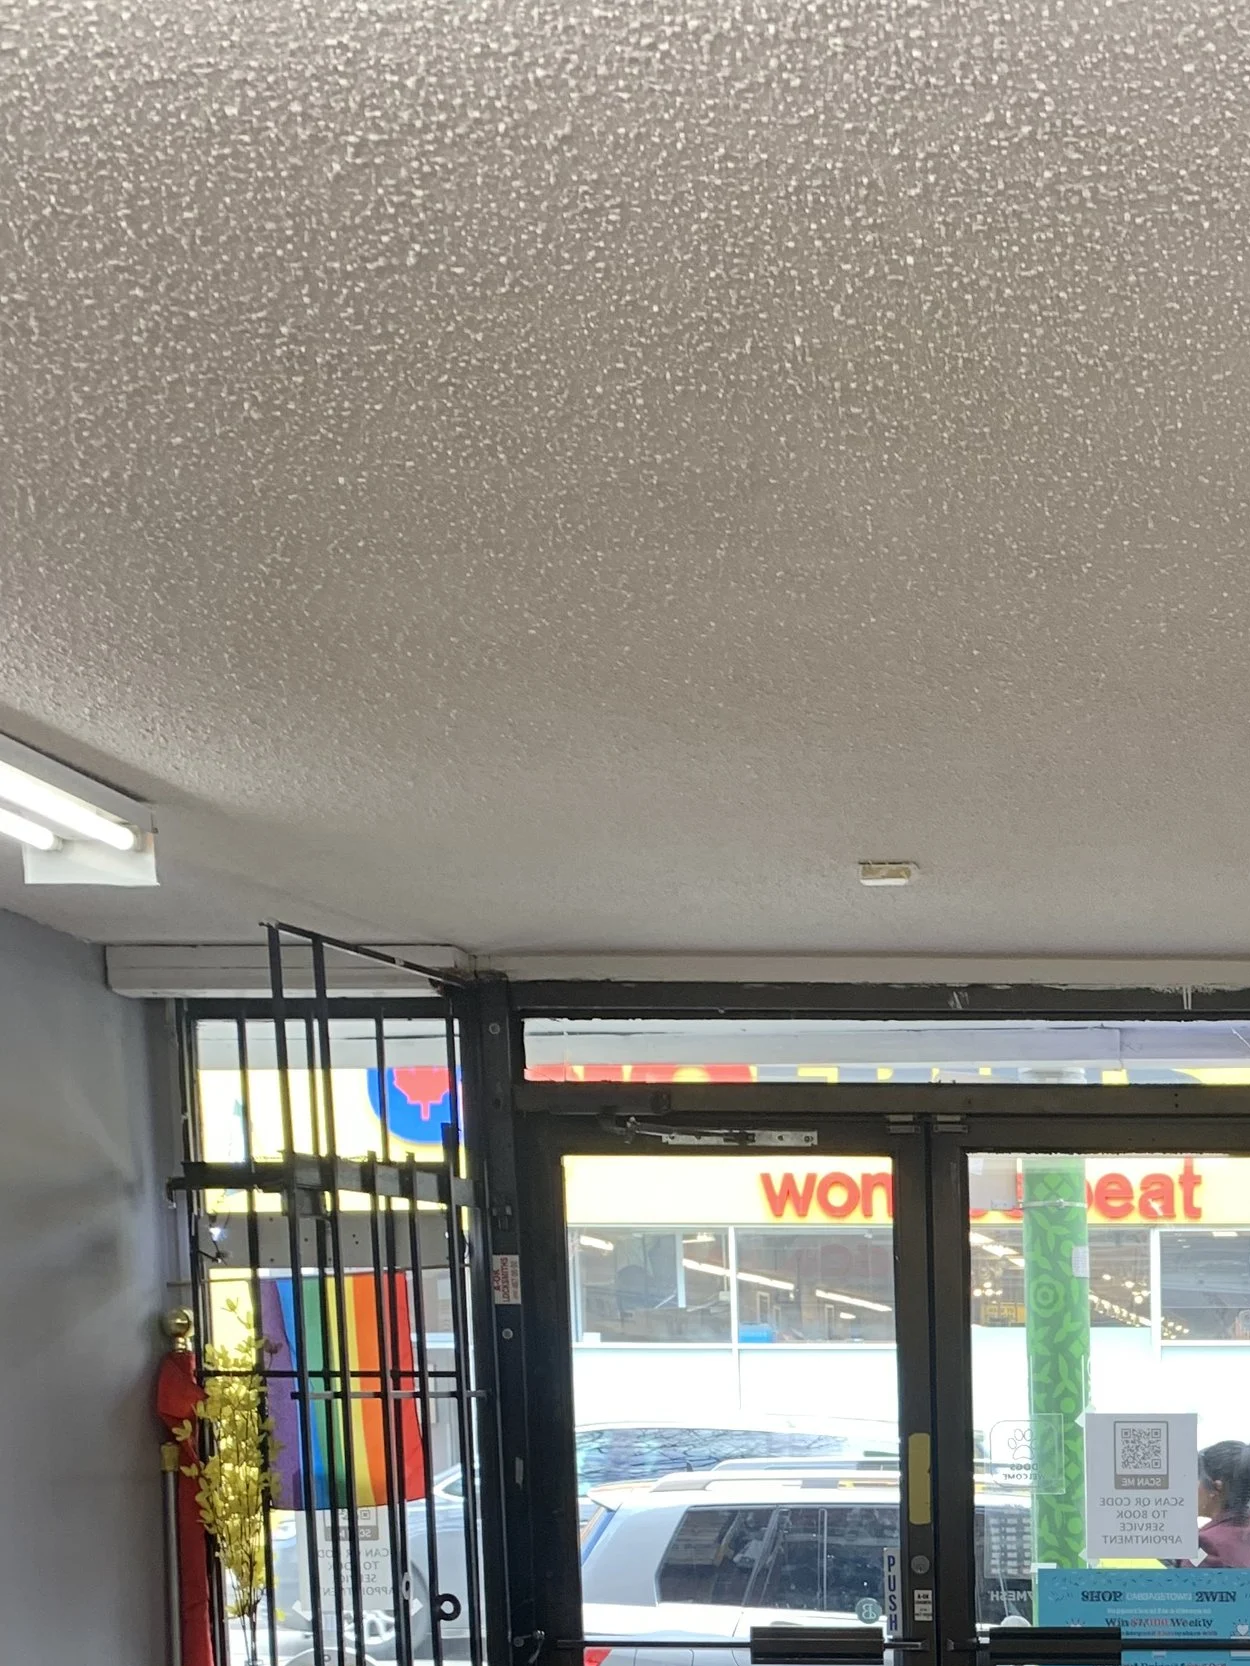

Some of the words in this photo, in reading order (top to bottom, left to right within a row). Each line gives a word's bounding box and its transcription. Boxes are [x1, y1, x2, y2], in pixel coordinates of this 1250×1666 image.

[887, 1554, 898, 1631] PUSH
[1081, 1590, 1123, 1602] SHOP
[1195, 1590, 1237, 1602] 2WIN
[1105, 1617, 1129, 1627] Win
[1169, 1617, 1213, 1628] Weekly
